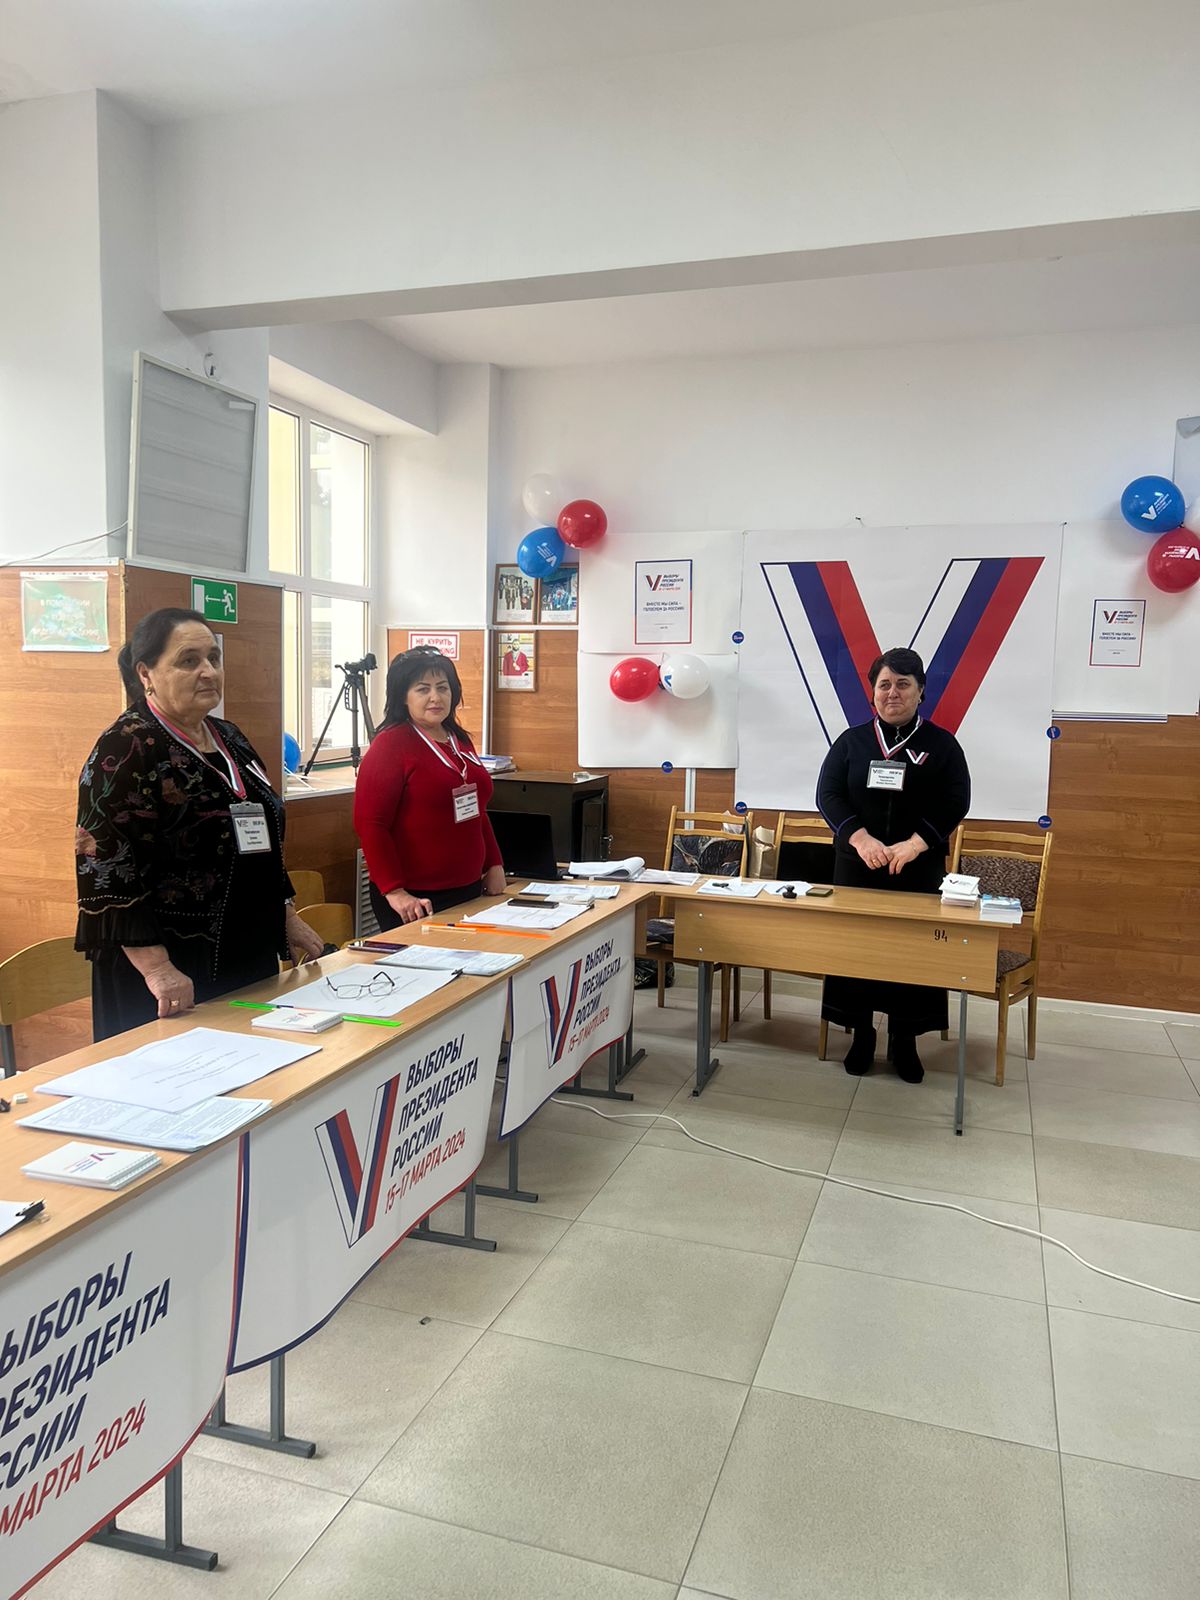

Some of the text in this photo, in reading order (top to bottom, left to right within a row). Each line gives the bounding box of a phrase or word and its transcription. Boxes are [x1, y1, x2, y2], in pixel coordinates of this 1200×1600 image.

[584, 938, 614, 974] ВЫБОРЫ
[934, 929, 948, 942] 94
[580, 957, 621, 1001] ПРЕЗИДЕНТА
[573, 992, 602, 1029] РОССИИ
[583, 1014, 598, 1040] МАРТА
[597, 1005, 610, 1027] 2024
[405, 1033, 465, 1093] ВЫБОРЫ
[398, 1056, 479, 1135] ПРЕЗИДЕНТА
[390, 1111, 444, 1177] РОССИИ
[408, 1146, 441, 1190] МАРТА
[442, 1127, 466, 1163] 2024
[0, 1251, 133, 1379] ЫБОРЫ
[0, 1398, 147, 1536] МАРТА 2024
